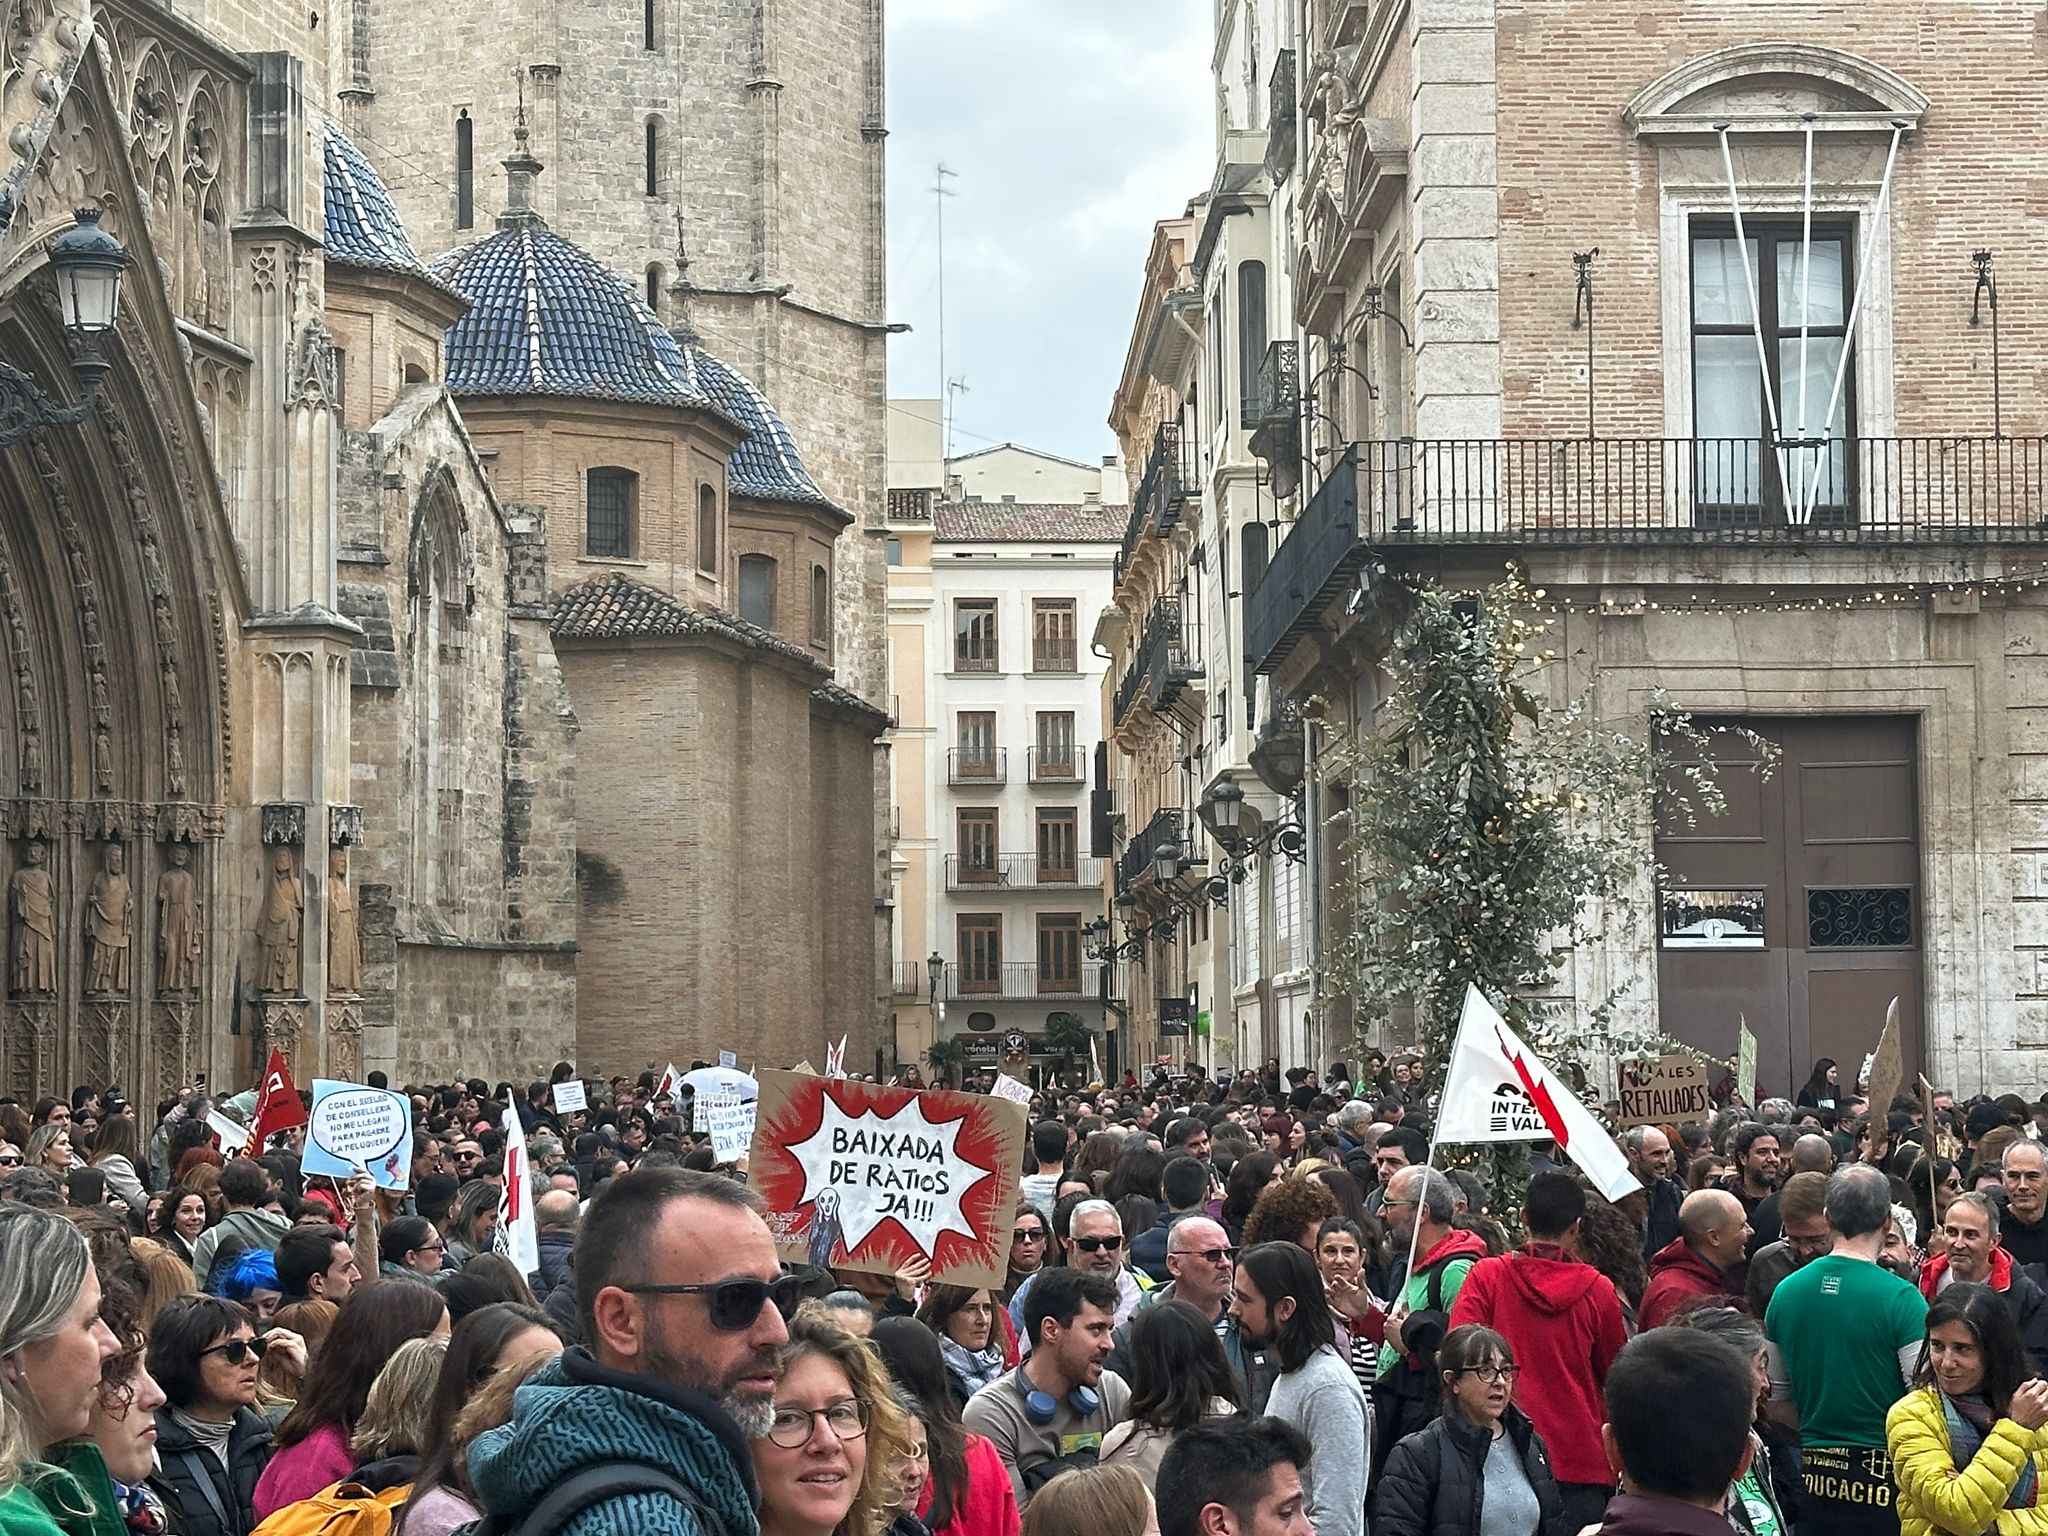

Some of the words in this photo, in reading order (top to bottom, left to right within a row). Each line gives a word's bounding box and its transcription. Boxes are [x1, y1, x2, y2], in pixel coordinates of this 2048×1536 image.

[1655, 1067, 1664, 1078] A
[1669, 1065, 1695, 1078] LES
[328, 1100, 346, 1110] CON
[347, 1099, 358, 1107] EL
[359, 1094, 388, 1106] SUELDO
[1491, 1101, 1536, 1115] INTE
[1620, 1085, 1705, 1118] RETALLADES
[325, 1113, 337, 1122] DE
[330, 1123, 342, 1132] NO
[343, 1121, 356, 1130] ME
[357, 1117, 382, 1128] LLEGA
[1511, 1117, 1549, 1131] VAL
[332, 1132, 355, 1143] PARA
[355, 1126, 391, 1138] PAGARME
[331, 1145, 344, 1154] LA
[832, 1126, 944, 1165] BAIXADA
[830, 1160, 858, 1185] DE
[866, 1163, 950, 1195] RÀTIOS
[875, 1193, 934, 1222] JA!!!
[1801, 1473, 1890, 1507] DUCACIÓ
